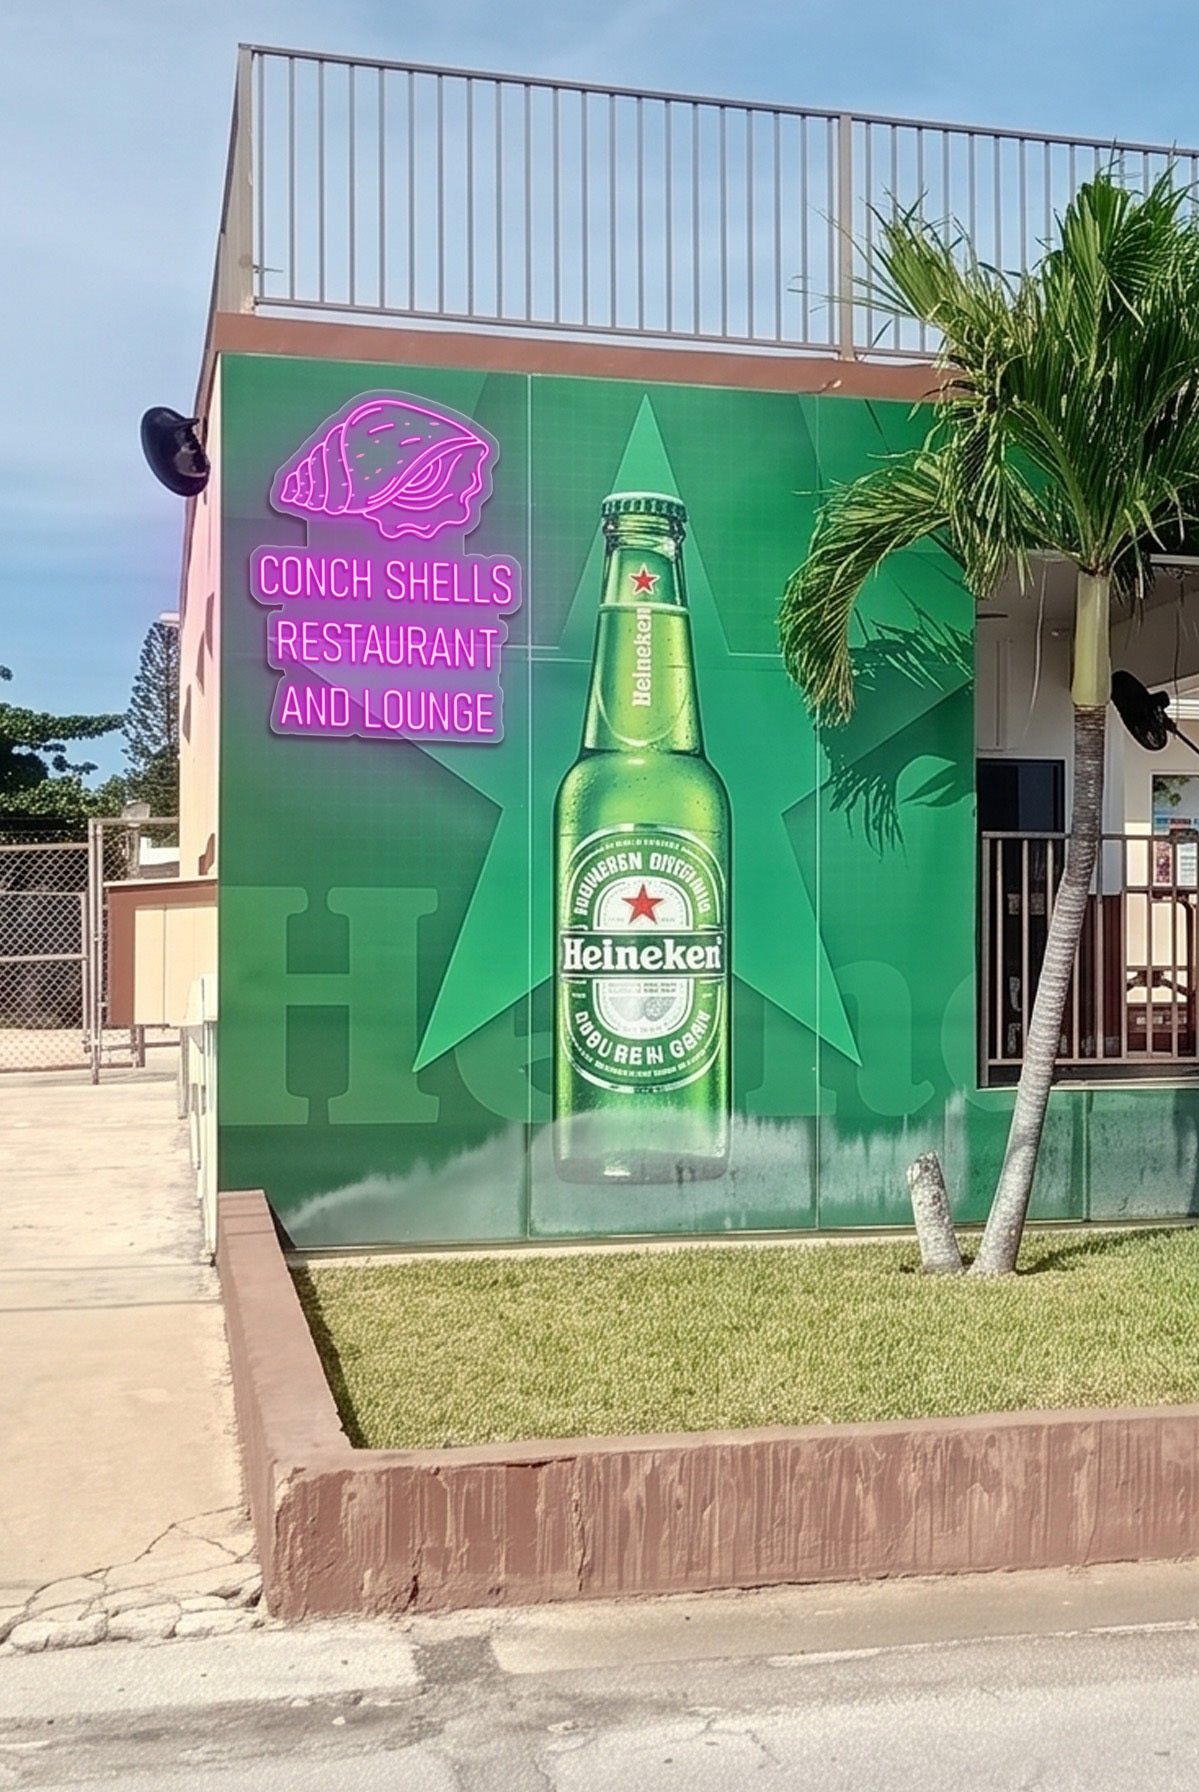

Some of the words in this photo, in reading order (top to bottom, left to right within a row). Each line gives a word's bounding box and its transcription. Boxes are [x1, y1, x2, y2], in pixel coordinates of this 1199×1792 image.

[259, 554, 372, 599] CONCH
[386, 560, 513, 605] SHELLS
[277, 620, 499, 669] RESTAURANT
[631, 607, 652, 707] Heineken
[281, 686, 350, 728] AND
[363, 690, 495, 733] LOUNGE
[563, 937, 721, 971] Heineken
